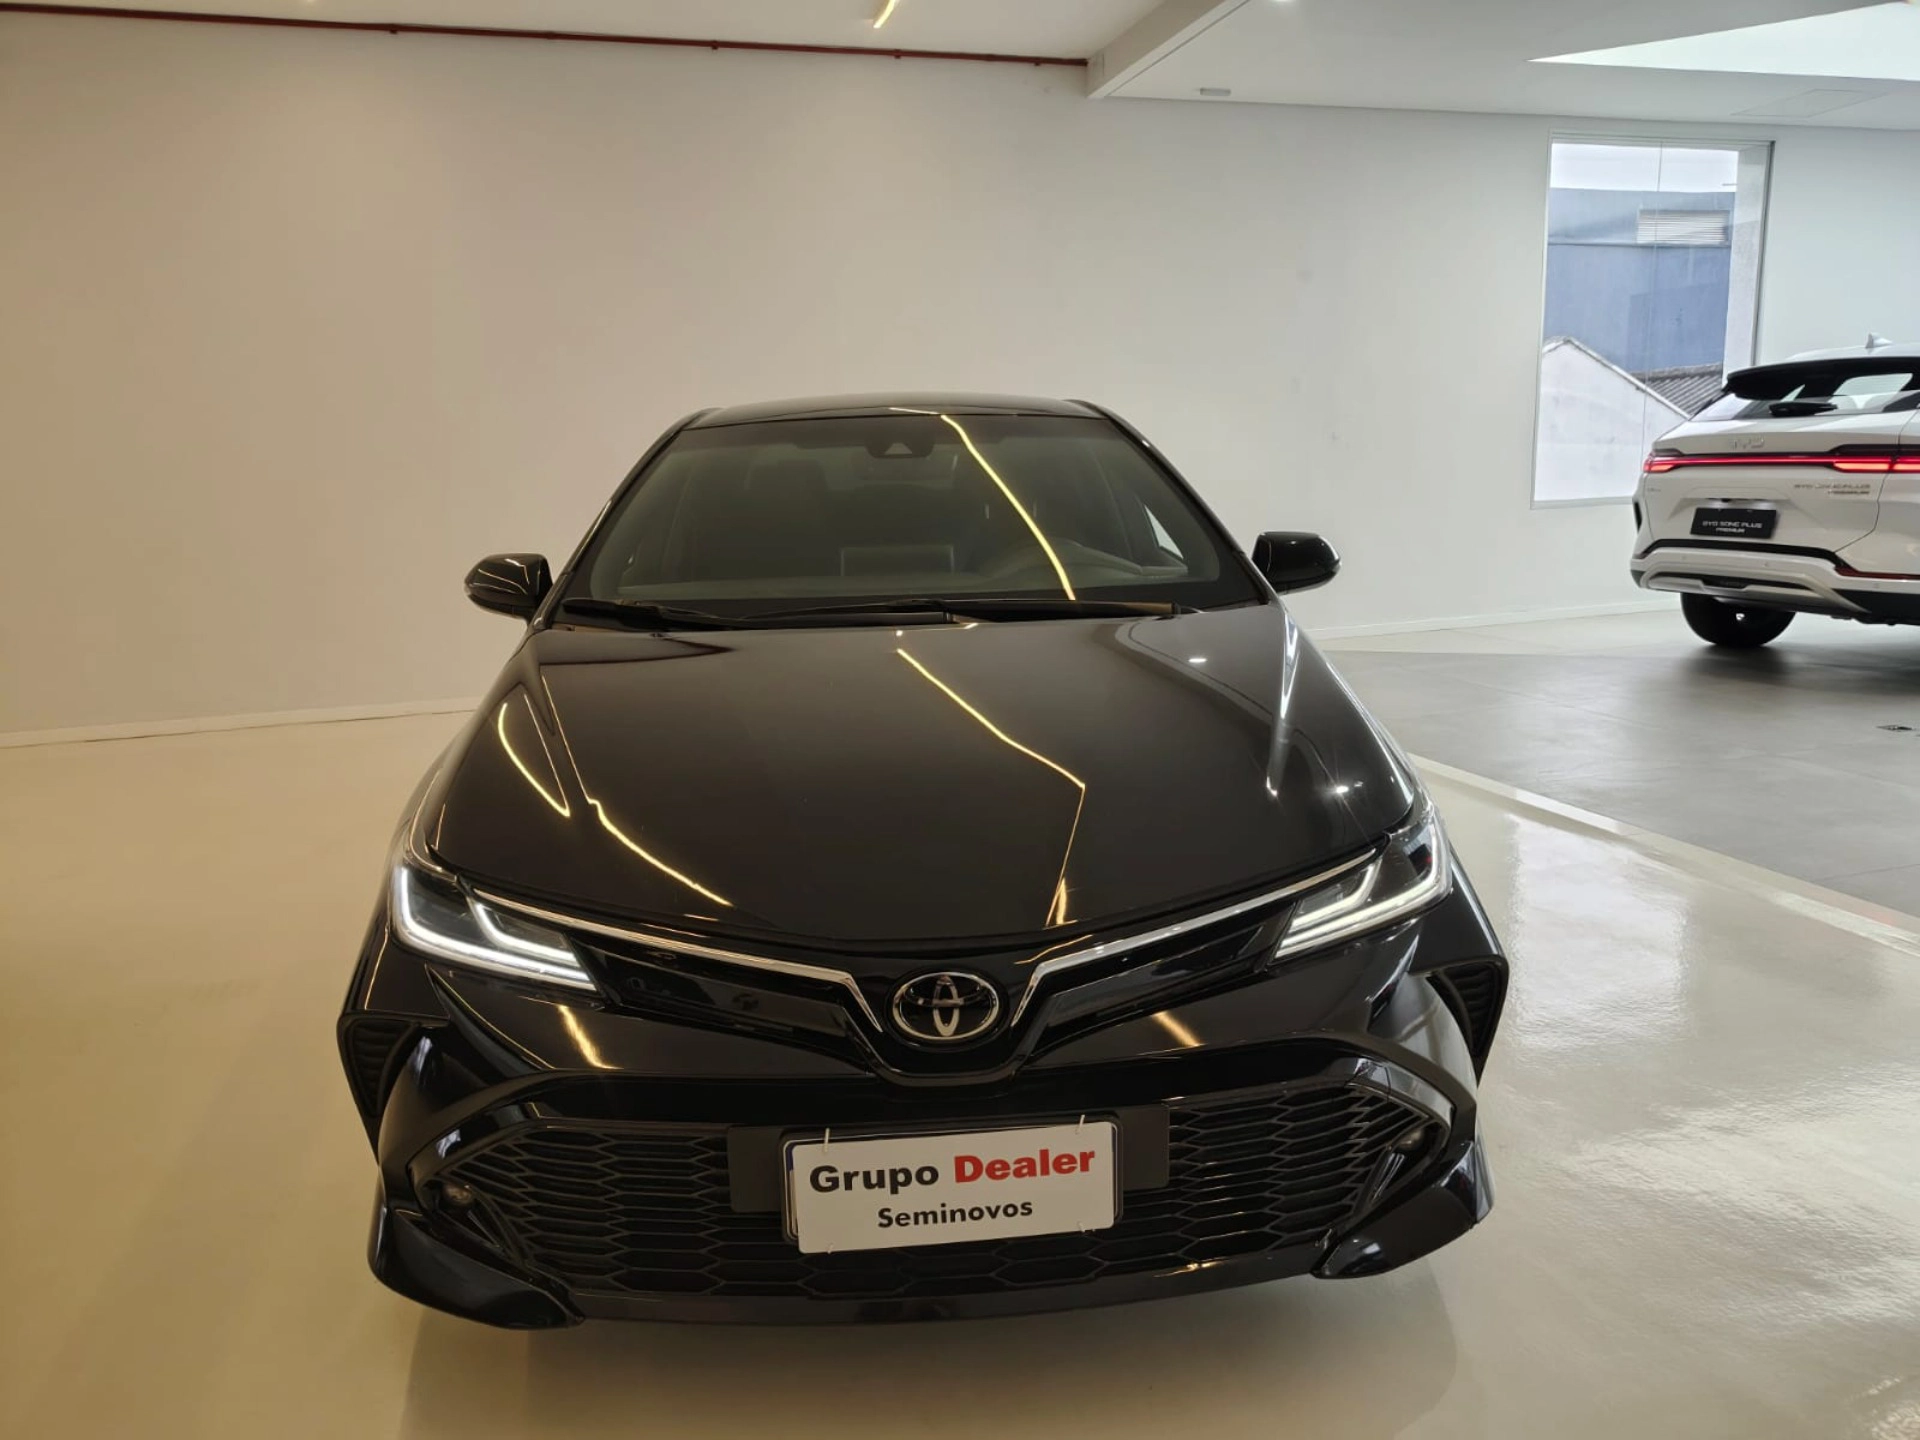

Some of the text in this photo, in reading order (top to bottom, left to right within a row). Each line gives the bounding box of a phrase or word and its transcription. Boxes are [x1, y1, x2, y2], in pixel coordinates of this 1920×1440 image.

[809, 1148, 1096, 1194] Grupo Dealer
[877, 1200, 1033, 1228] Seminovos
